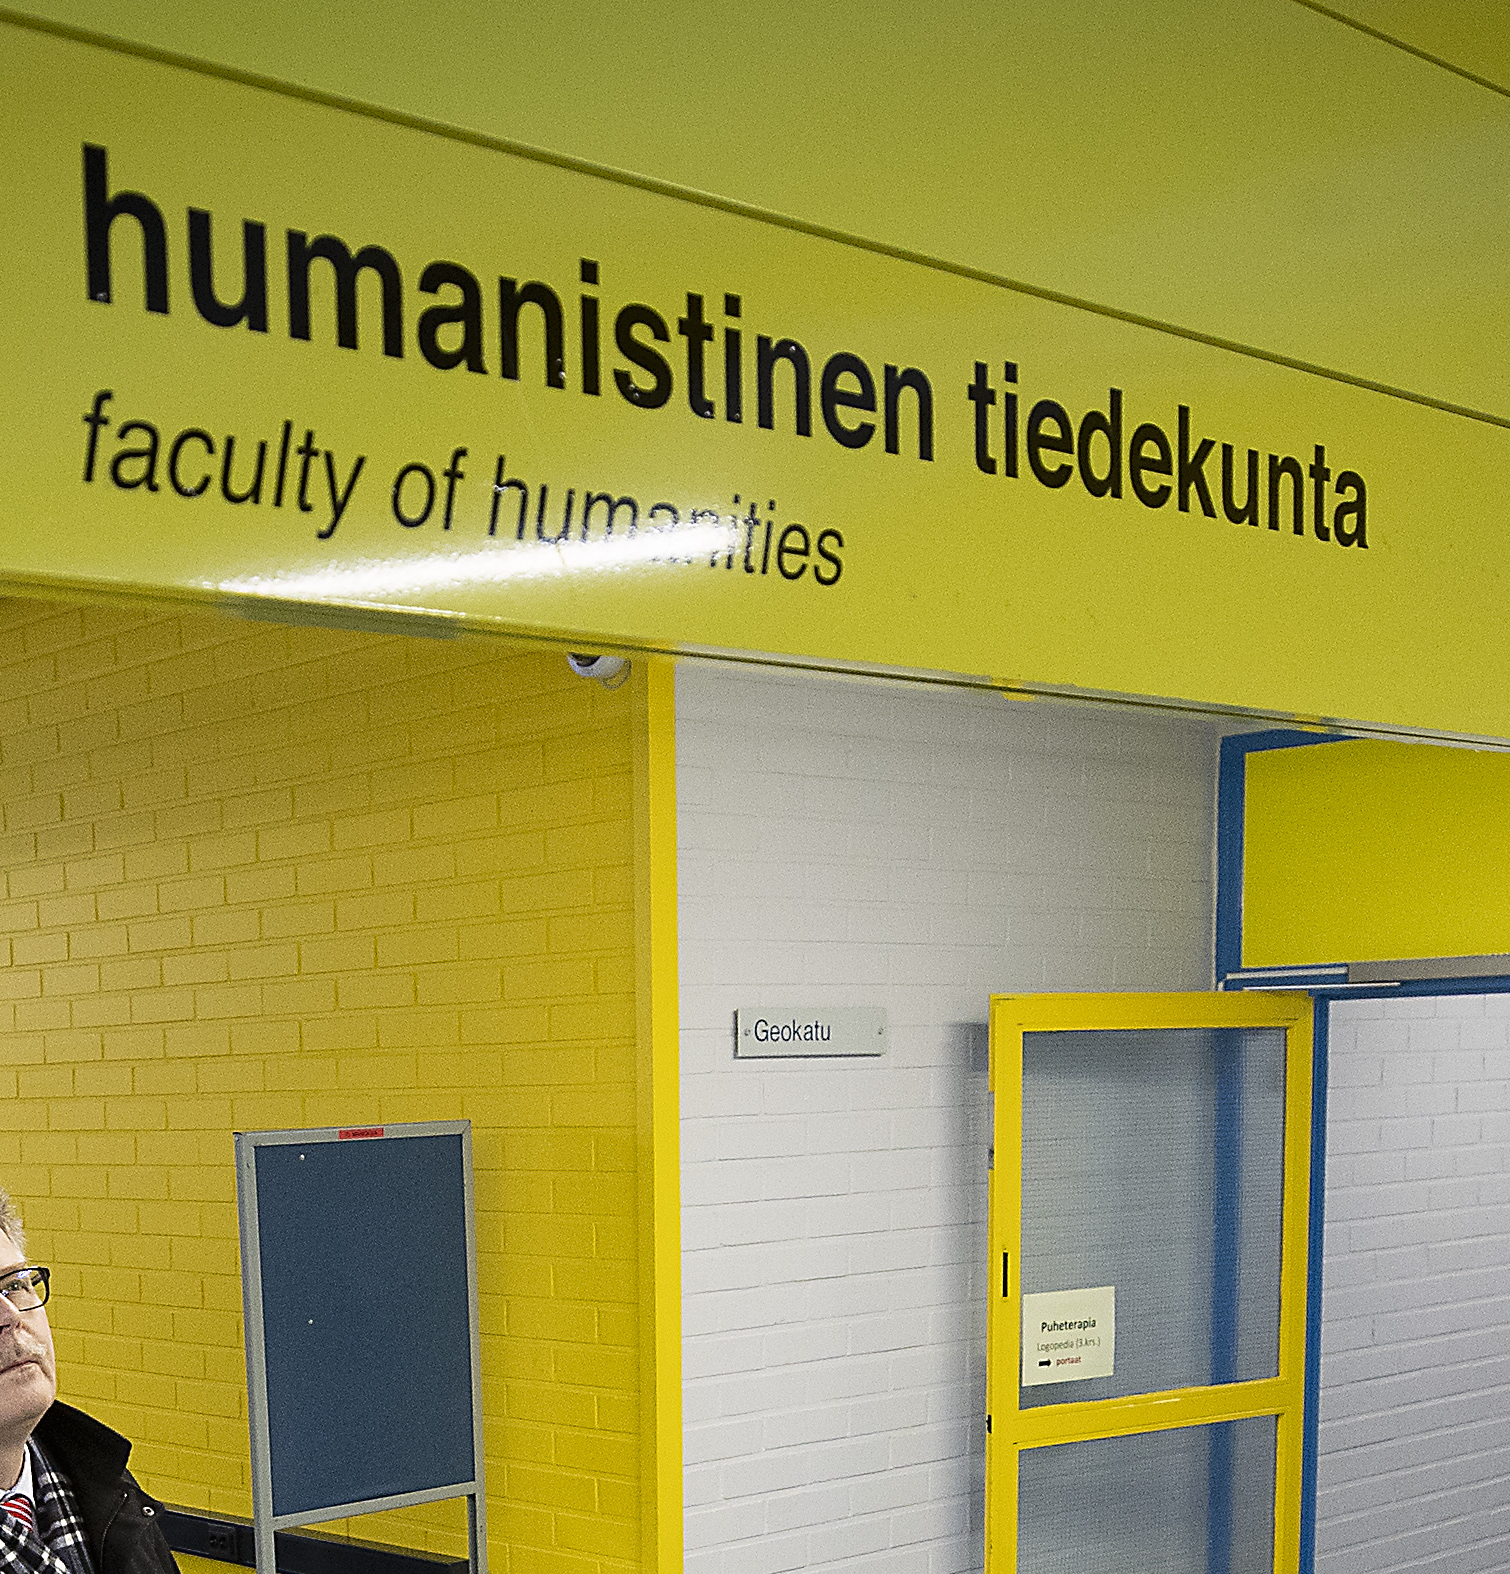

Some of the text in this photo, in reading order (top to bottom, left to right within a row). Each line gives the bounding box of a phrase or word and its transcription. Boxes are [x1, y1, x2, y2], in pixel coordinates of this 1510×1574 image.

[83, 142, 1369, 549] humanistinen tiedekunta
[83, 390, 845, 586] faculty of humanities
[754, 1019, 831, 1042] Geokatu
[1041, 1316, 1097, 1333] Puheterapia
[1036, 1340, 1075, 1353] Logopedia
